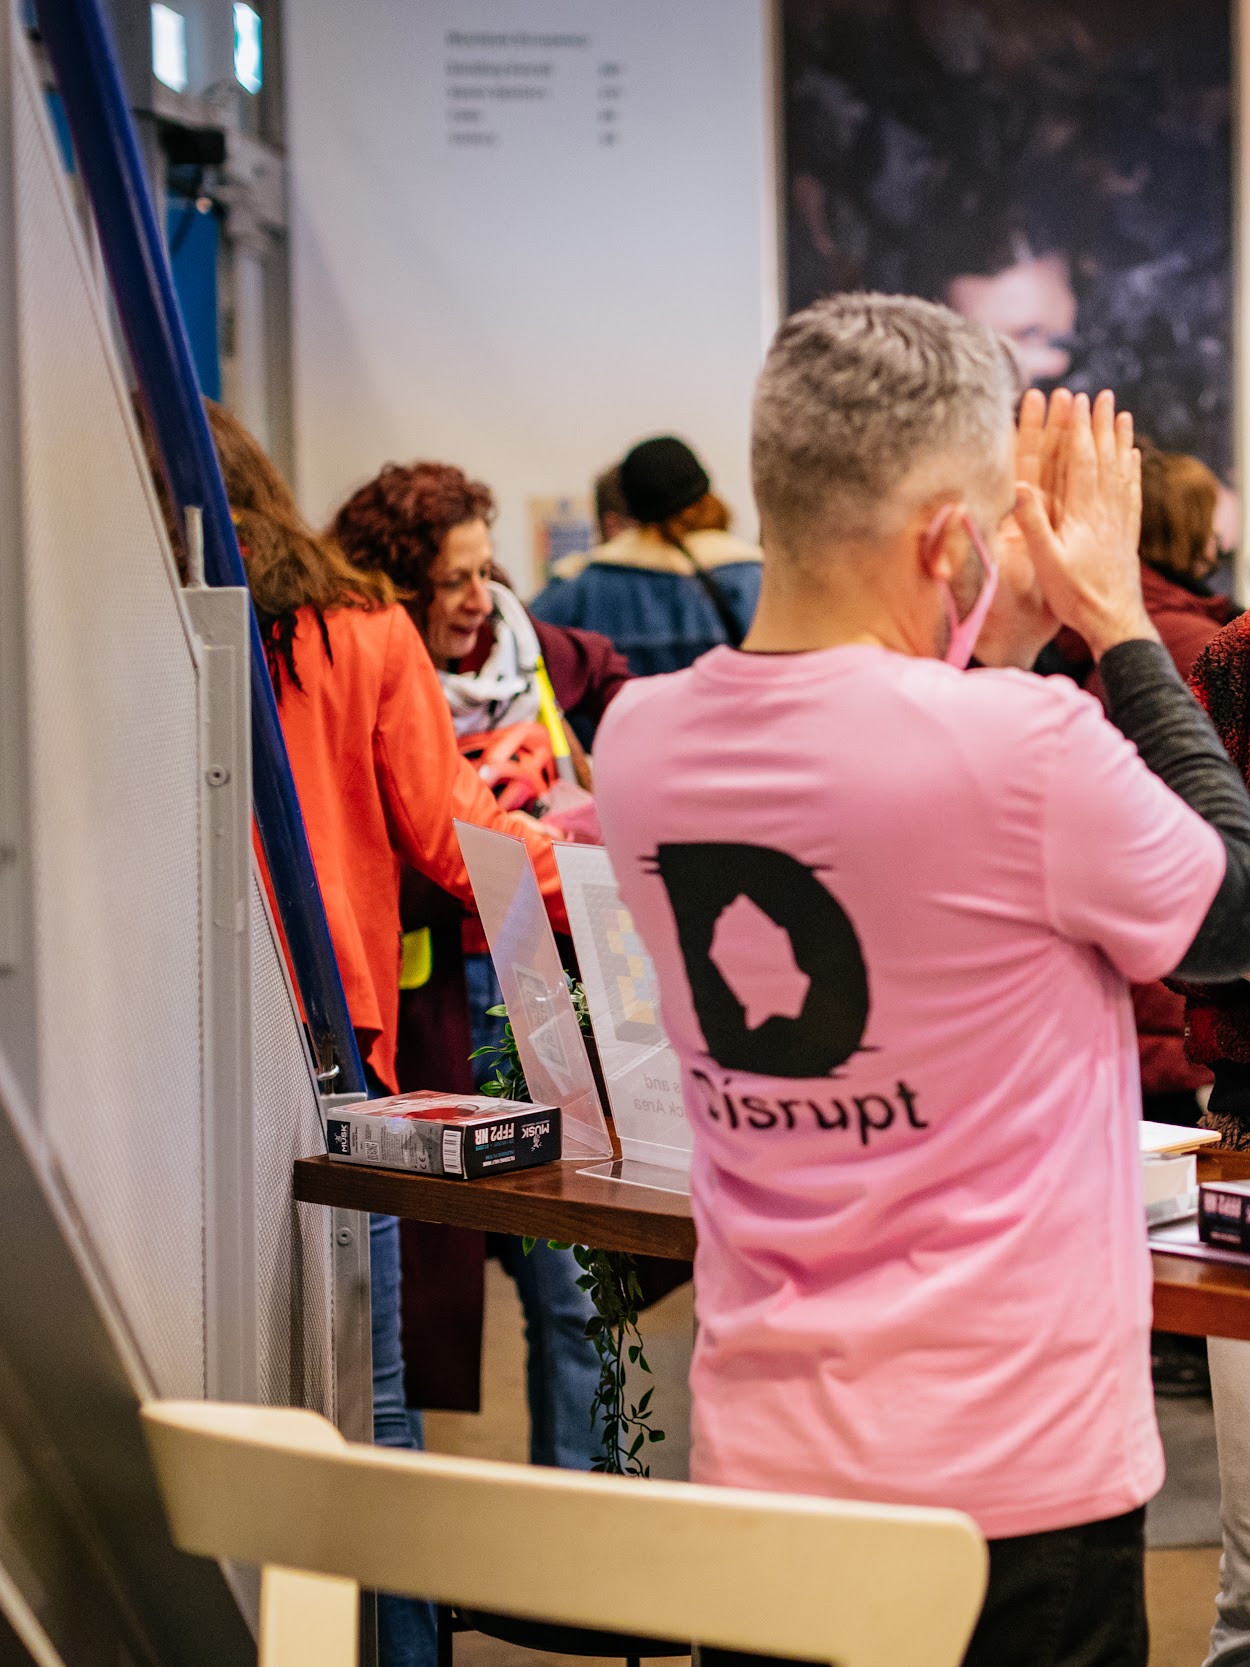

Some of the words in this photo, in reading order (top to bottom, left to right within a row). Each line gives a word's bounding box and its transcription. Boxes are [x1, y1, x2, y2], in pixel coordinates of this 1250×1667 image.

[640, 841, 878, 1079] D
[341, 1123, 349, 1153] MUSK
[474, 1126, 488, 1145] NR
[491, 1122, 515, 1141] FFP2
[521, 1122, 550, 1139] MUSK
